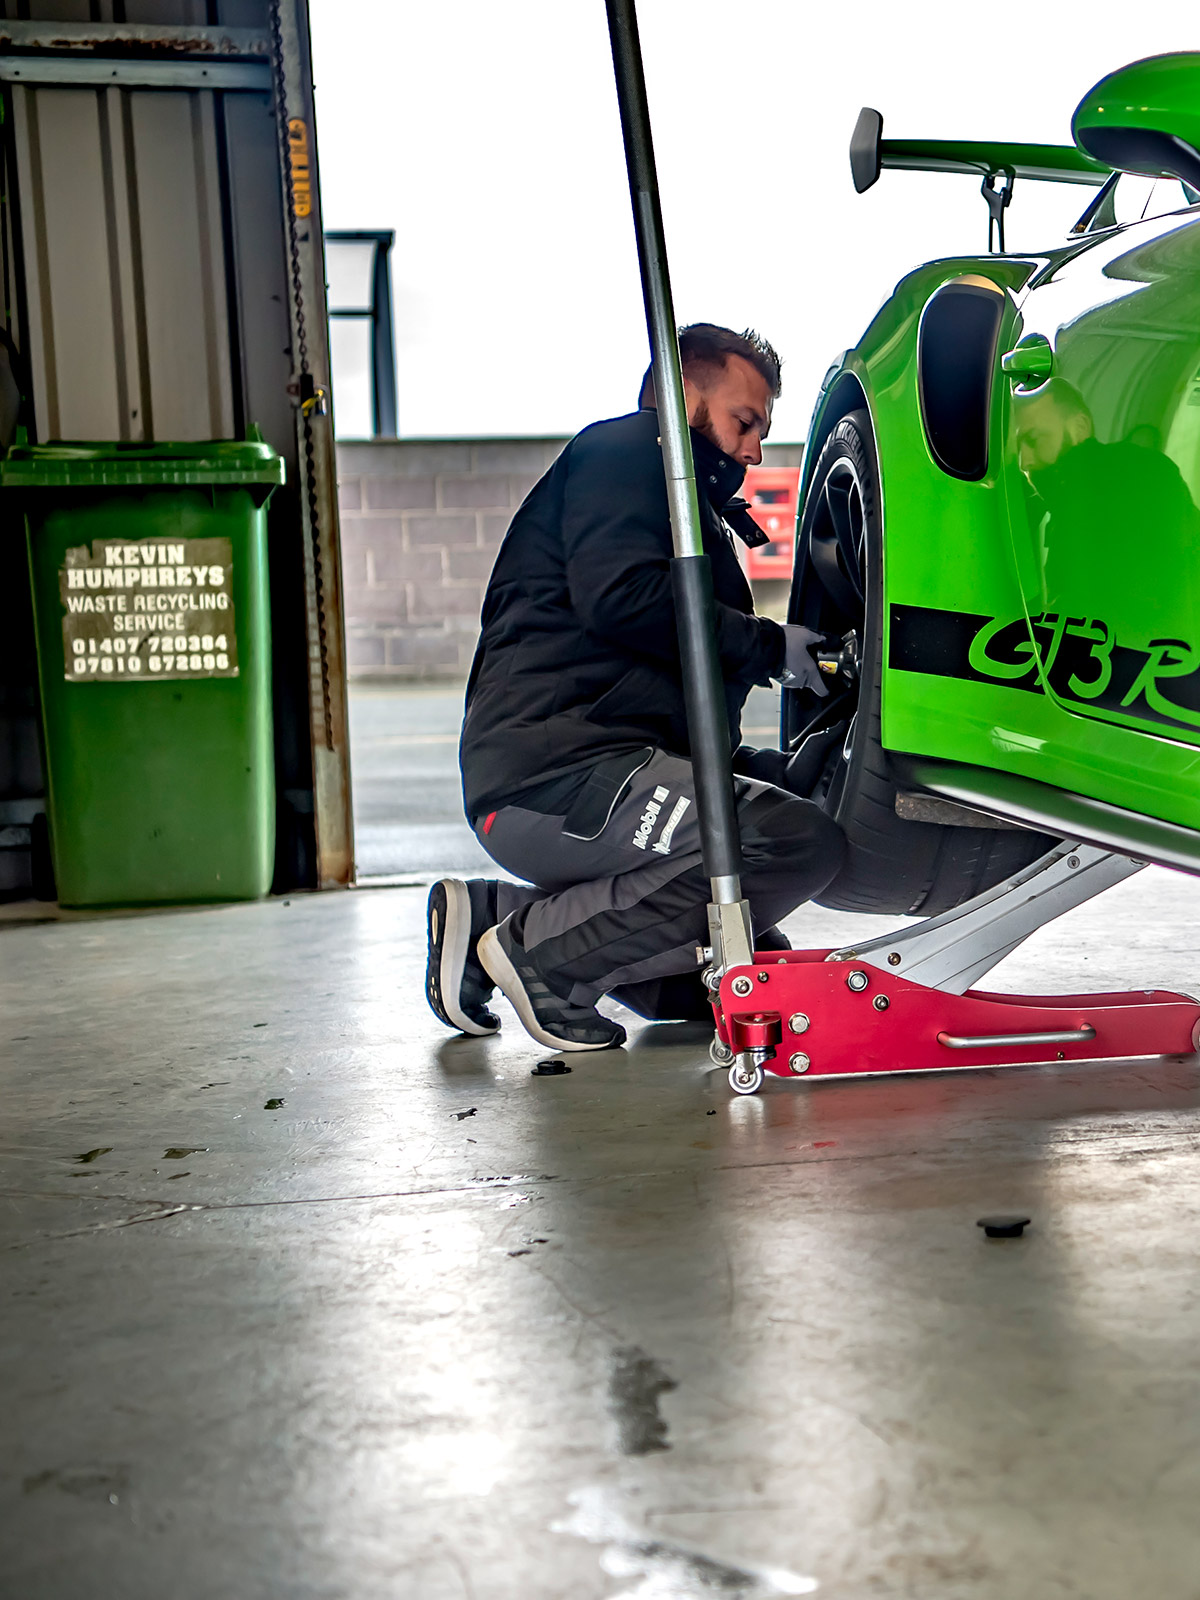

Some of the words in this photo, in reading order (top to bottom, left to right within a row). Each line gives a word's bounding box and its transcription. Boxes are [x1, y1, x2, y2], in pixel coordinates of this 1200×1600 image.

[105, 545, 184, 566] KEVIN
[67, 566, 225, 589] HUMPHREYS
[67, 595, 127, 613] WASTE
[134, 592, 228, 612] RECYCLING
[113, 613, 185, 632] SERVICE
[72, 637, 139, 655] 01407
[148, 634, 228, 653] 720384
[73, 656, 141, 674] 07810
[968, 611, 1116, 700] GT3
[632, 800, 662, 850] Mobil
[660, 797, 690, 849] MICHELIN
